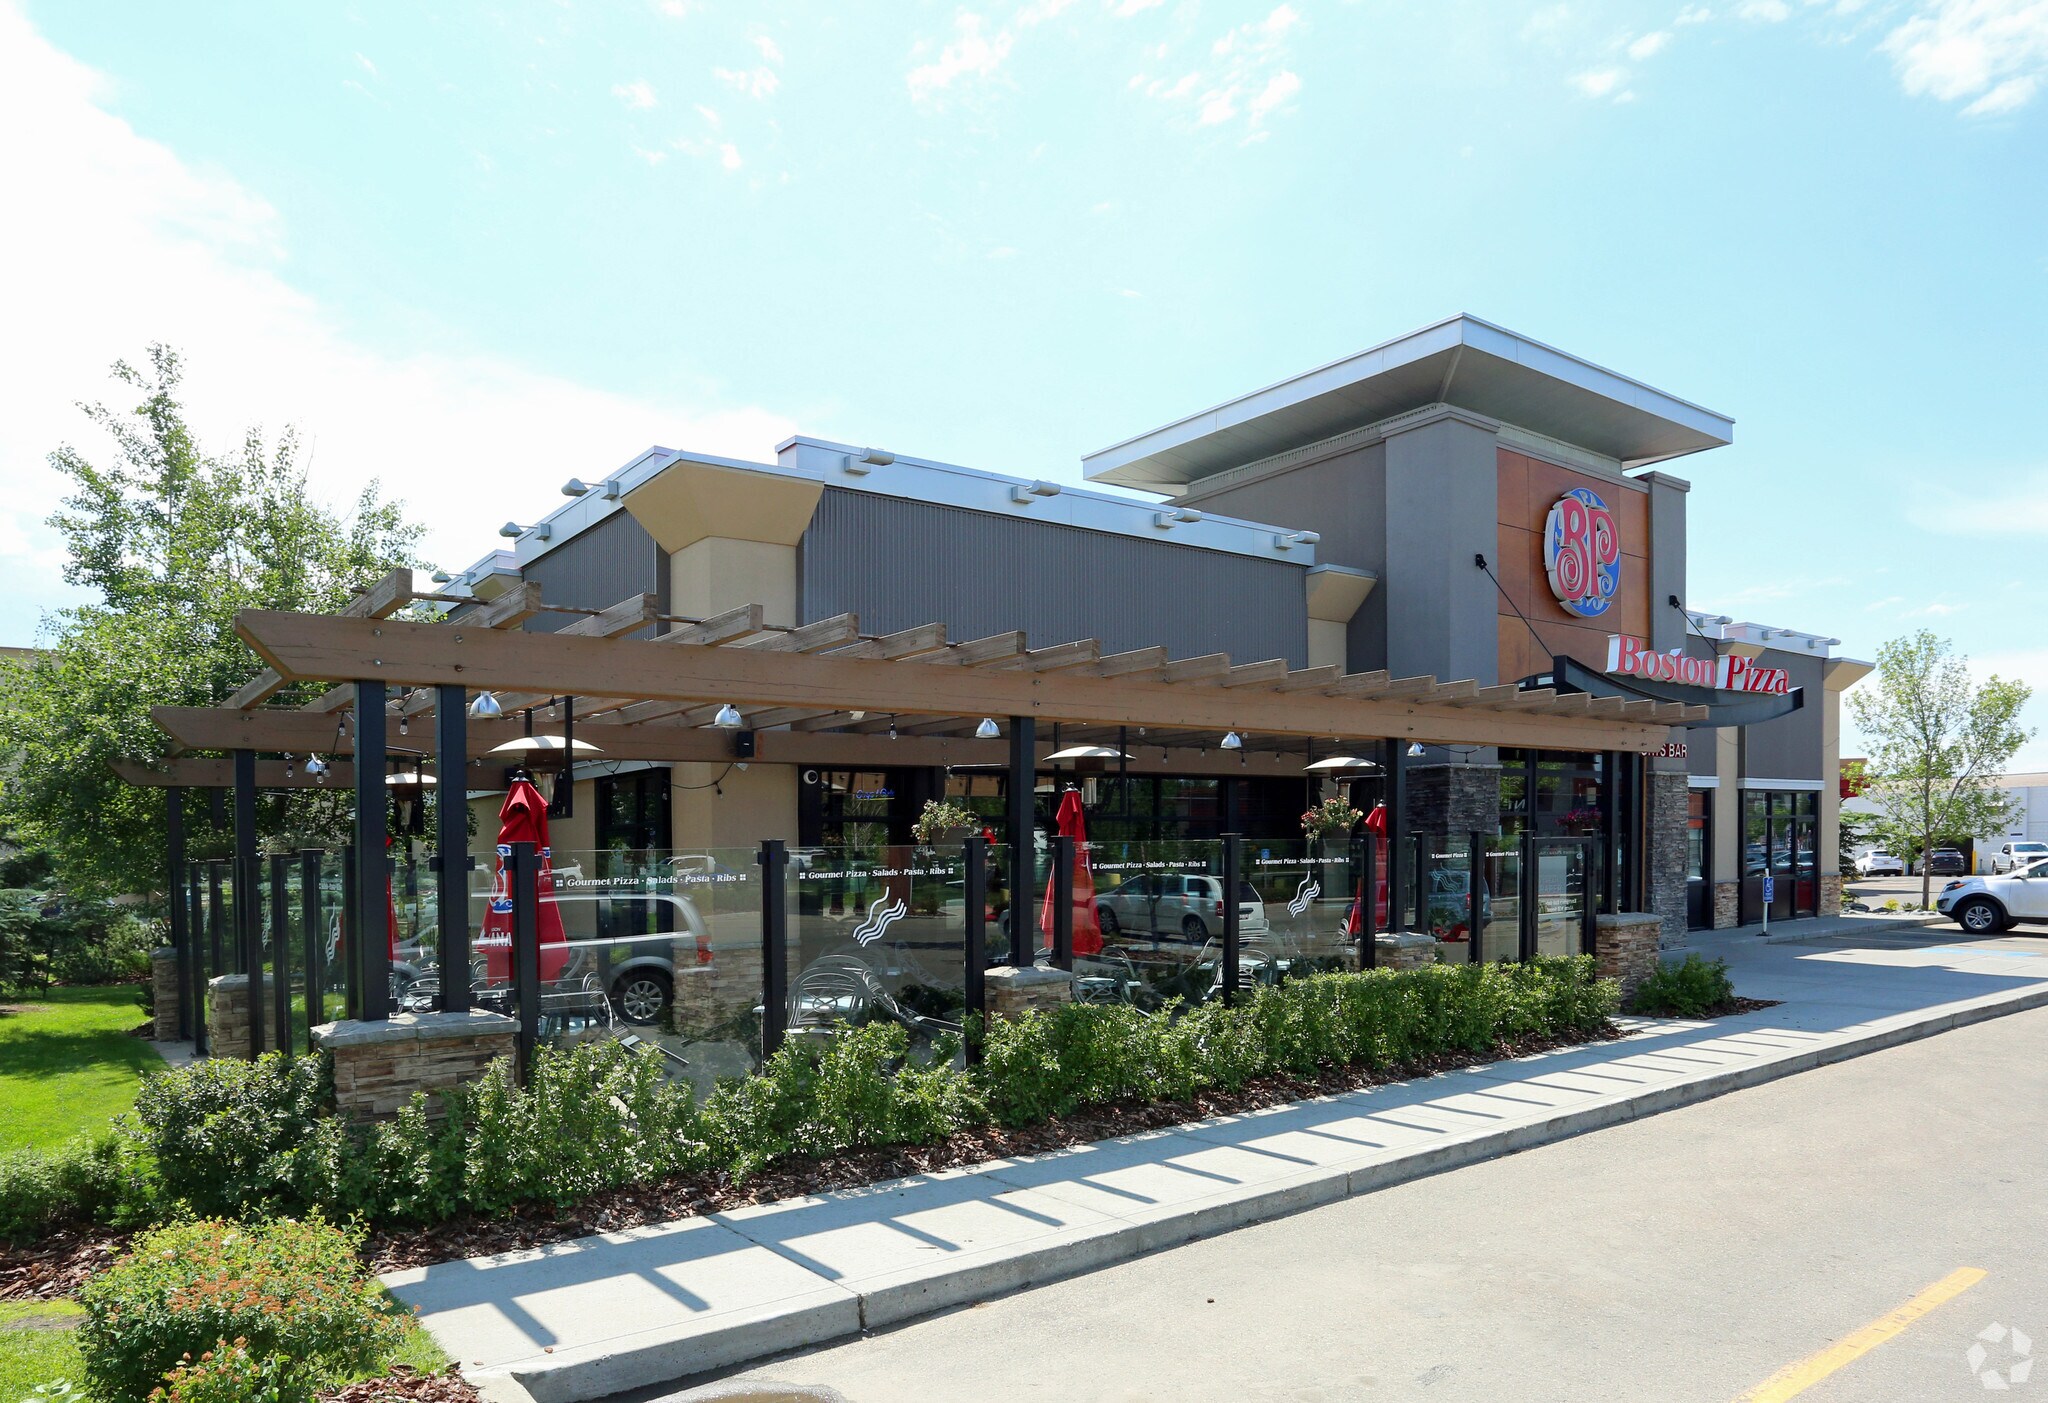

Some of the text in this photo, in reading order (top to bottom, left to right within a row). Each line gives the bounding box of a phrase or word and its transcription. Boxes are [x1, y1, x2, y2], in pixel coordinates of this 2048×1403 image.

[1614, 634, 1790, 695] Boston Pizza
[1669, 743, 1687, 758] BAR
[808, 867, 946, 879] Gourmet Pizza Salads Pasta Ribs
[1099, 862, 1125, 870] Gourmet
[567, 873, 737, 887] Gourmet Pizza Salads Pasta Ribs
